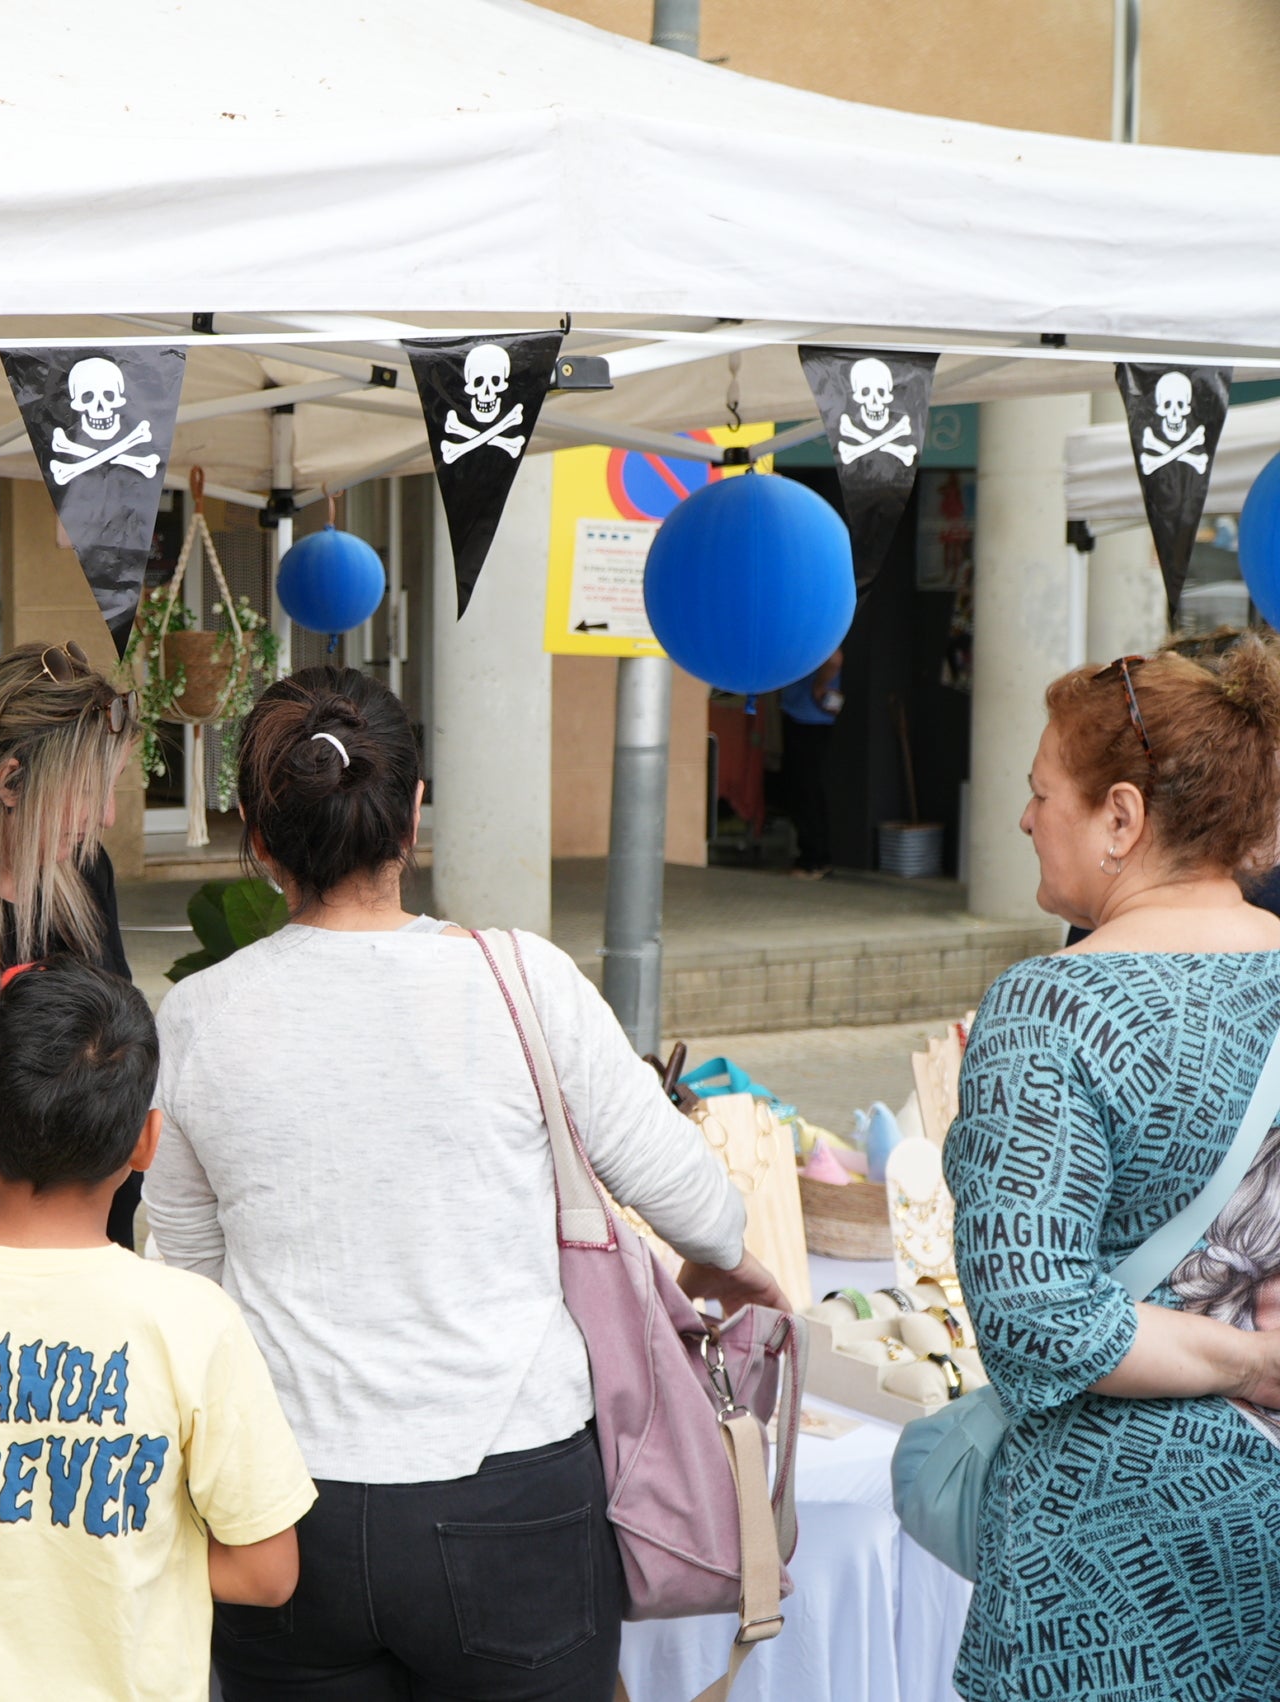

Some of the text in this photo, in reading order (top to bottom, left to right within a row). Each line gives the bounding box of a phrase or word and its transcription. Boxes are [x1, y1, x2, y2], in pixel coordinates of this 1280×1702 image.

[993, 977, 1137, 1074] THINKING
[1172, 977, 1215, 1107] INTELLIGENCE
[996, 1053, 1065, 1201] BUSINESS
[1186, 1041, 1242, 1141] CREATIVE
[994, 1193, 1018, 1211] IDEA
[1143, 1176, 1182, 1198] MIND
[1052, 1308, 1138, 1384] IMPROVEMENT
[1032, 1398, 1124, 1537] CREATIVE
[1151, 1457, 1247, 1512] VISION
[1165, 1448, 1204, 1464] MIND
[1076, 1492, 1154, 1526] IMPROVEMENT
[1148, 1515, 1204, 1537] CREATIVE
[1011, 1545, 1067, 1618] IDEA
[1055, 1543, 1140, 1626] INNOVATIVE
[1110, 1532, 1211, 1680] THINKING
[1172, 1531, 1241, 1657] INNOVATIVE
[1226, 1515, 1267, 1639] INSPIRATION
[1121, 1624, 1147, 1644] IDEA
